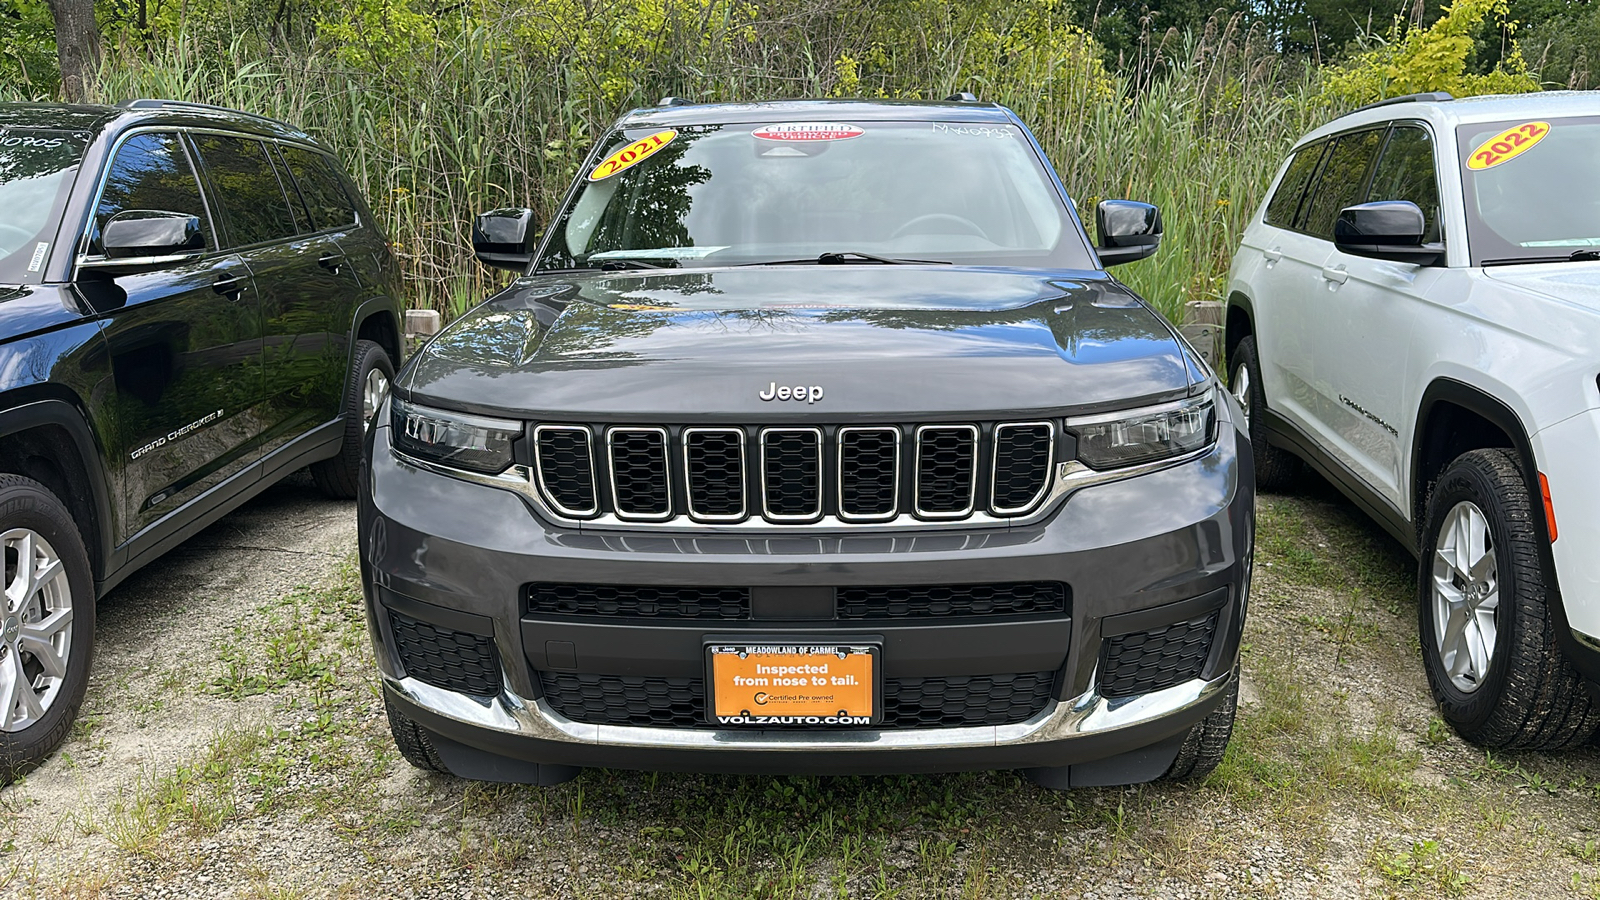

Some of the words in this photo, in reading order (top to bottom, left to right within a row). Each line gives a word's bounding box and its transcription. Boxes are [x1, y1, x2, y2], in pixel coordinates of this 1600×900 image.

[603, 135, 667, 174] 2021
[1475, 124, 1547, 166] 2022
[759, 381, 824, 405] Jeep
[130, 437, 166, 460] GRAND
[167, 412, 216, 441] CHEROKEE
[745, 646, 797, 655] MEADOWLAND
[798, 646, 808, 655] OF
[809, 646, 841, 655] CARMEL
[756, 663, 828, 677] Inspected
[733, 676, 769, 687] from
[773, 678, 808, 687] nose
[811, 677, 827, 687] to
[831, 675, 859, 687] tail.
[717, 716, 870, 725] VOLZAUTO.COM
